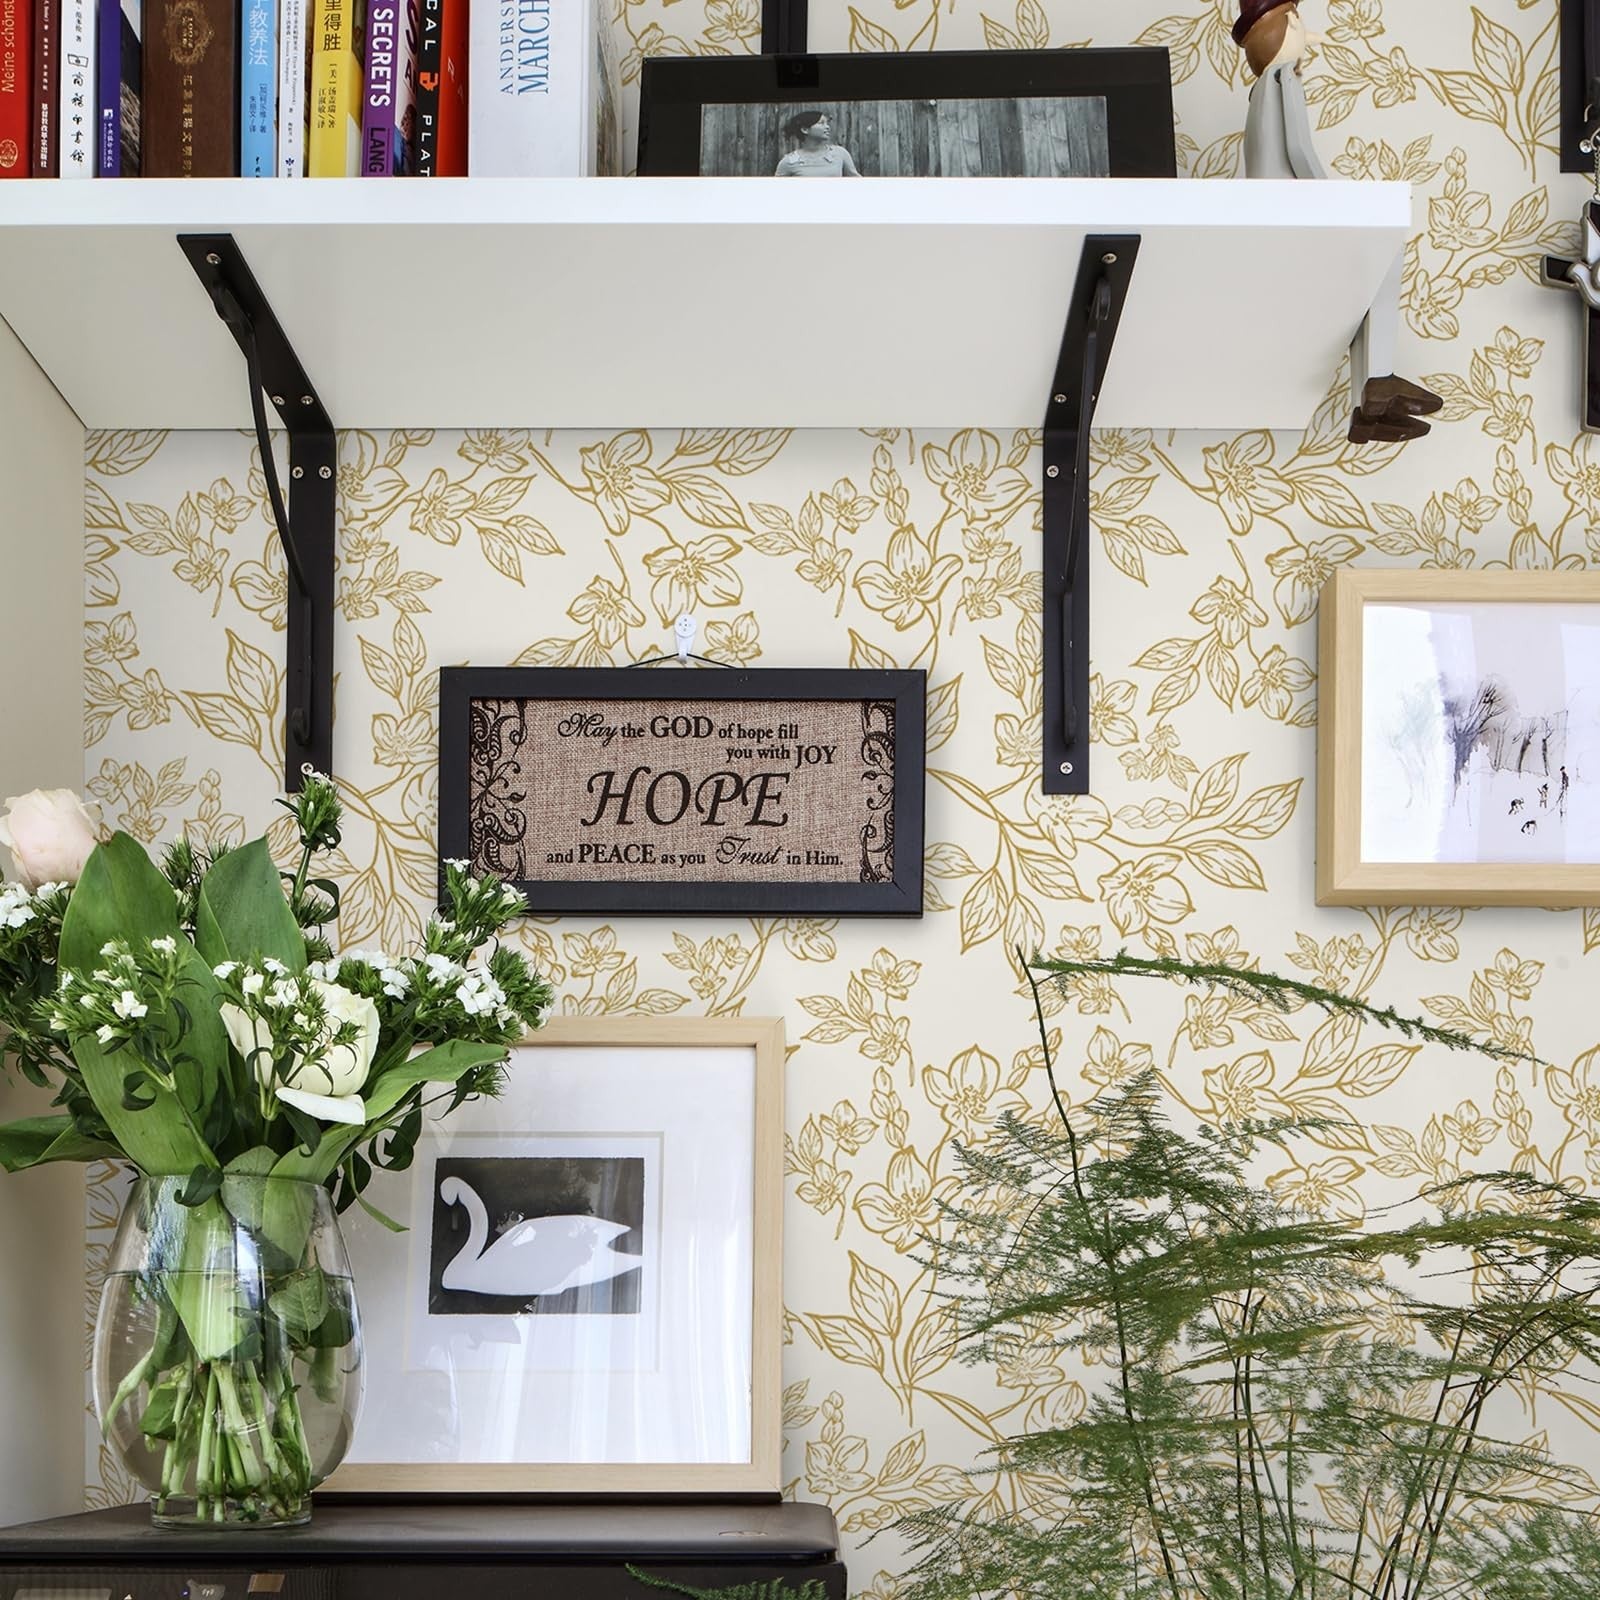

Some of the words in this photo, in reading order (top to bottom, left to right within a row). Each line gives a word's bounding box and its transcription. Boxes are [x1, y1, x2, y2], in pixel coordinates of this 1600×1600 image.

[370, 8, 394, 107] SECRETS
[500, 0, 514, 95] ANDERS
[1, 51, 15, 93] Meine
[368, 127, 386, 173] LANG
[557, 713, 617, 747] May
[621, 723, 645, 738] the
[650, 715, 714, 739] GOD
[718, 723, 735, 739] of
[737, 723, 774, 743] hope
[777, 724, 799, 739] fill
[726, 747, 753, 763] you
[757, 744, 790, 759] with
[795, 745, 837, 768] JOY
[580, 766, 791, 827] HOPE
[547, 852, 574, 864] and
[578, 844, 656, 864] PEACE
[660, 855, 676, 864] as
[679, 854, 706, 868] you
[716, 836, 782, 865] Trust
[786, 851, 800, 865] in
[805, 851, 844, 865] Him.
